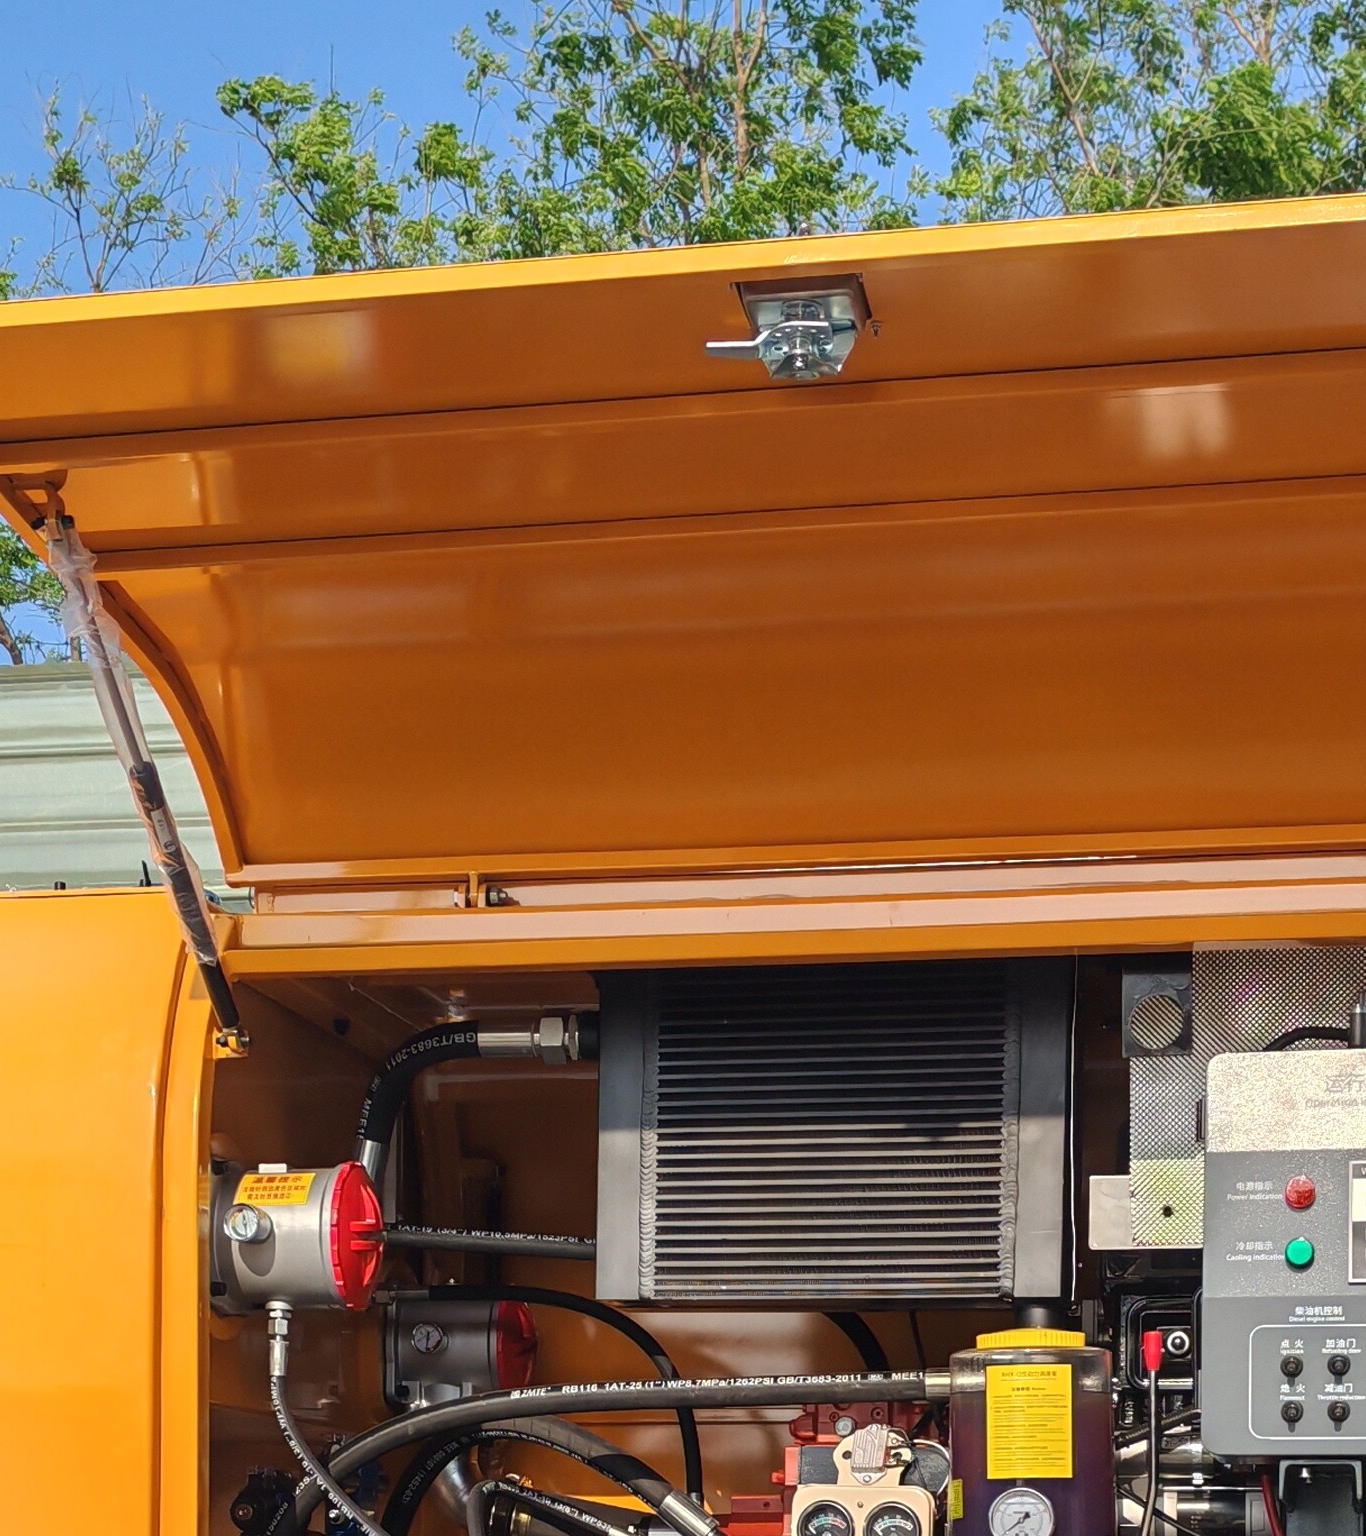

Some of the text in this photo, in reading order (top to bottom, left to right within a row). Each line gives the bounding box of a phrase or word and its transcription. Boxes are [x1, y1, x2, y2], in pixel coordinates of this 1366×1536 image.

[1236, 1181, 1273, 1191] 电源指示
[1235, 1241, 1274, 1251] 冷却指示
[1295, 1306, 1342, 1315] 柴油机控制
[562, 1383, 597, 1394] RB116
[604, 1380, 642, 1391] 1AT-25
[777, 1373, 861, 1386] GB/T3683-2011
